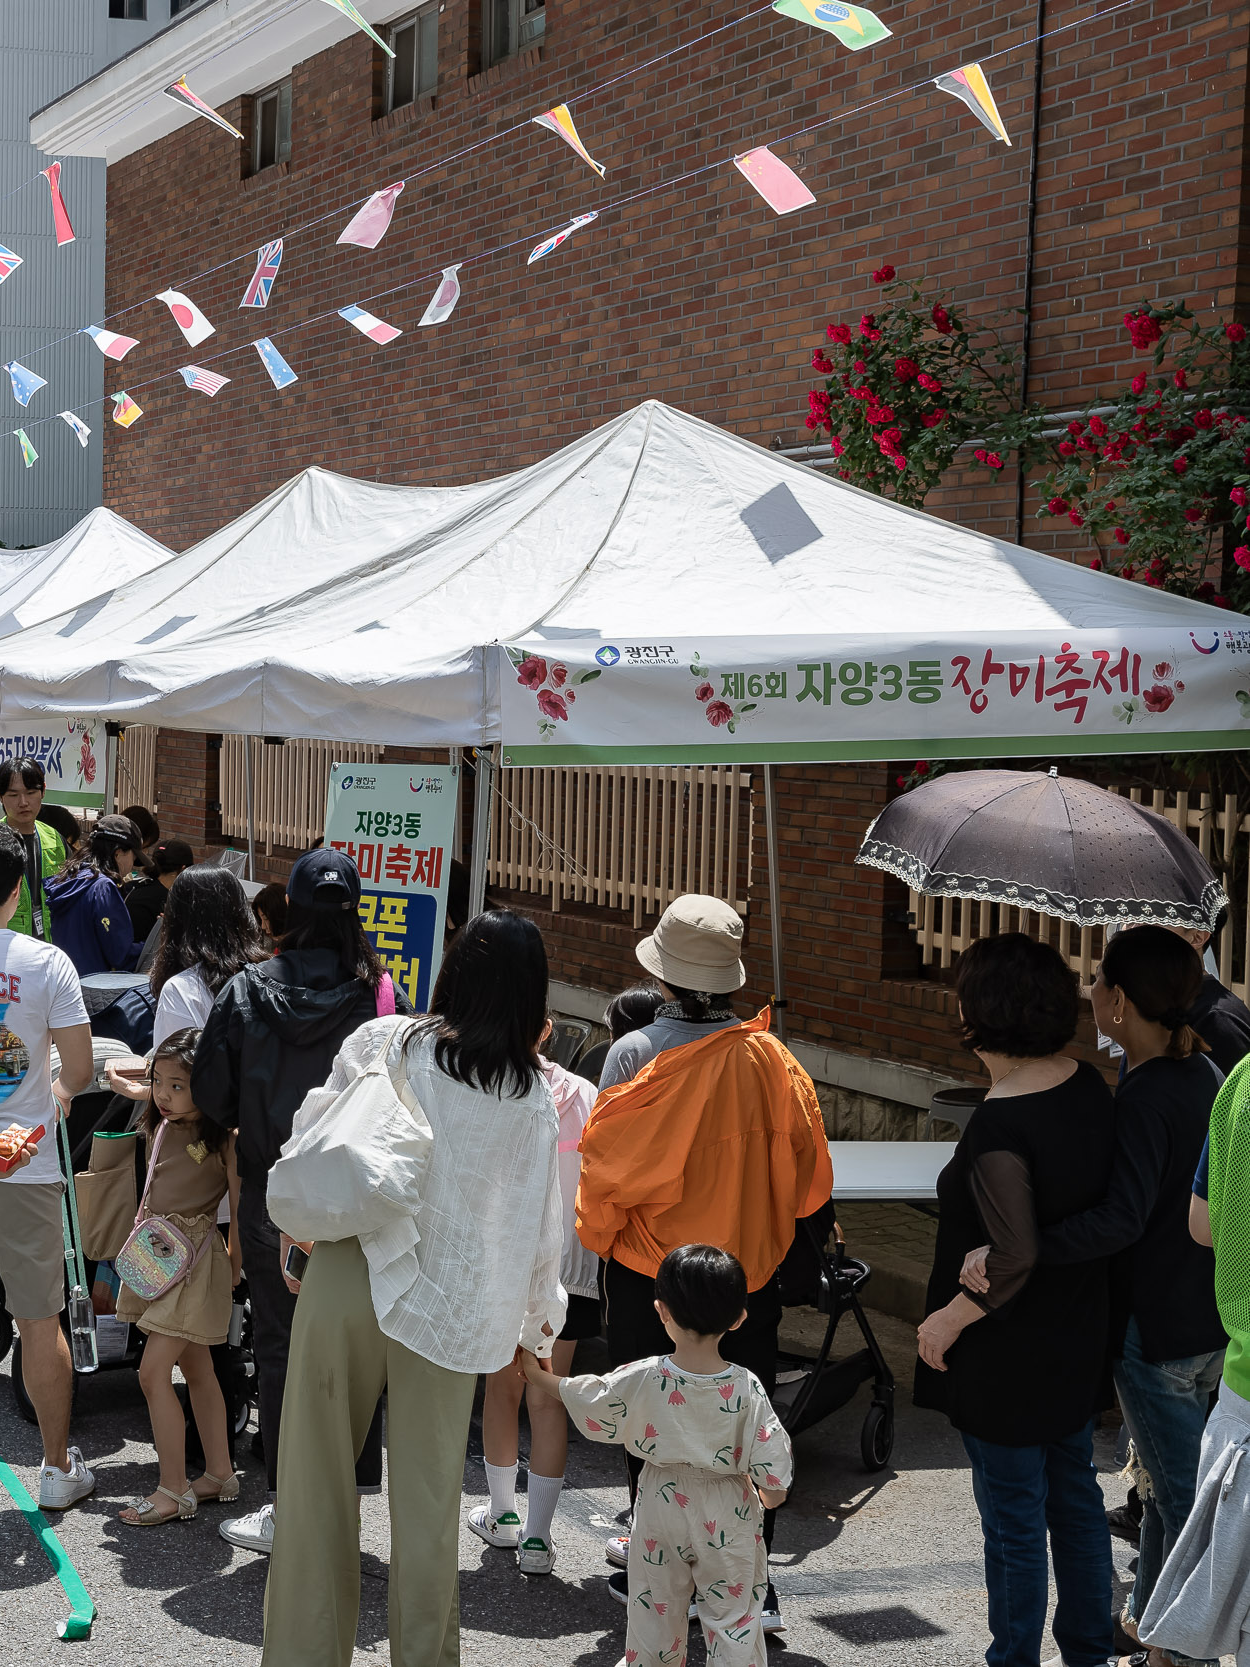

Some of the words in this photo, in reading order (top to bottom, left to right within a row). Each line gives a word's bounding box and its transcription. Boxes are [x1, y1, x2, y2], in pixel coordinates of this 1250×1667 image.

[624, 645, 676, 659] 광진구
[627, 657, 679, 665] GWANGJIN-GU
[720, 671, 788, 700] 제6회
[795, 660, 944, 706] 자양3동
[950, 642, 1142, 724] 장미축제
[355, 777, 376, 785] 광진구
[354, 811, 421, 839] 자양3동
